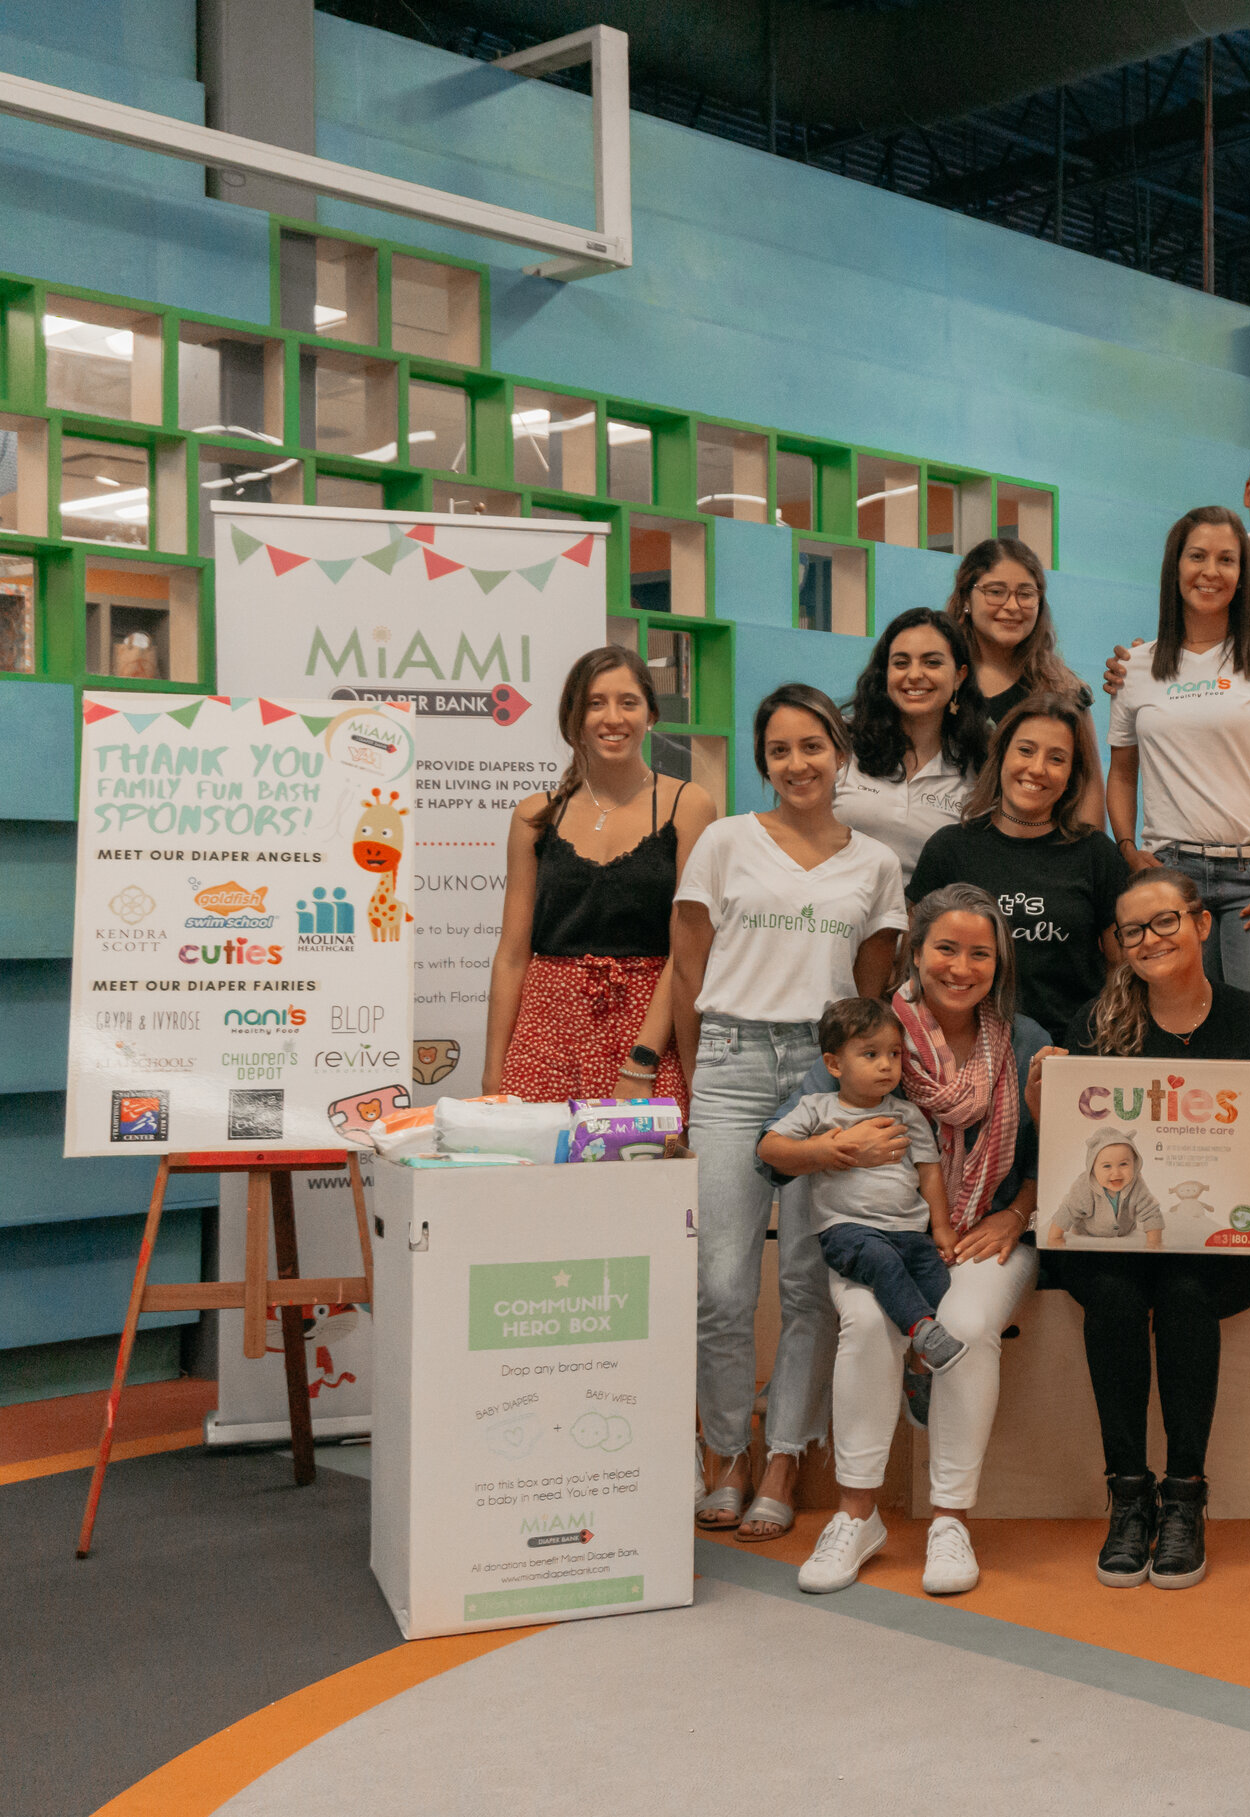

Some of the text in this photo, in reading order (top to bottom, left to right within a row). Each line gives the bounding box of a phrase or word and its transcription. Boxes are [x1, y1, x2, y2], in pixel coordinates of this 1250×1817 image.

[1167, 676, 1231, 695] nani's
[436, 691, 489, 713] BANK
[94, 743, 229, 777] THANK
[250, 743, 324, 778] YOU
[416, 760, 558, 772] PROVIDE DIAPERS TO
[98, 778, 321, 802] FAMILY FUN BASH
[416, 779, 509, 790] REN LIVING IN
[428, 799, 473, 809] HAPPY
[478, 799, 488, 809] &
[491, 799, 520, 809] HEA
[920, 791, 963, 813] revive
[94, 801, 313, 836] SPONSORS!
[97, 850, 322, 863] MEET OUR DIAPER ANGELS
[414, 875, 508, 891] OUKNOW
[200, 891, 260, 906] goldfish
[185, 915, 274, 928] swim school
[96, 929, 168, 940] KENDRA
[429, 925, 442, 936] to
[447, 923, 469, 937] buy
[474, 923, 503, 937] diap
[102, 941, 161, 953] SCOTT
[297, 934, 355, 945] MOLINA
[178, 937, 284, 965] cuties
[297, 945, 355, 953] HEALTHCARE
[428, 957, 456, 969] with
[460, 957, 490, 969] food
[92, 980, 317, 992] MEET OUR DIAPER FAIRIES
[450, 992, 490, 1004] Florid
[96, 1010, 200, 1031] GRYPH & IVYROSE
[224, 1004, 307, 1026] nani's
[331, 1005, 385, 1034] BLOP
[231, 1027, 300, 1036] Healthy Food
[314, 1050, 400, 1068] revive
[1078, 1074, 1240, 1125] cuties
[1155, 1125, 1235, 1136] complete care
[1232, 1234, 1248, 1244] 180
[493, 1293, 629, 1317] COMMUNITY
[503, 1315, 612, 1338] HERO BOX
[501, 1360, 619, 1377] Drop any brand new
[585, 1389, 638, 1405] BABY WIPES
[475, 1393, 540, 1420] BABY DIAPERS
[475, 1467, 641, 1492] into this box and you've helped
[476, 1498, 485, 1507] a
[488, 1494, 518, 1506] baby
[521, 1493, 530, 1502] in
[566, 1486, 599, 1498] You're
[601, 1487, 610, 1495] a
[612, 1482, 639, 1494] hero!
[471, 1563, 482, 1573] All
[483, 1559, 527, 1572] donations
[529, 1555, 560, 1567] benefit
[561, 1553, 586, 1564] Miami
[587, 1550, 616, 1563] Diaper
